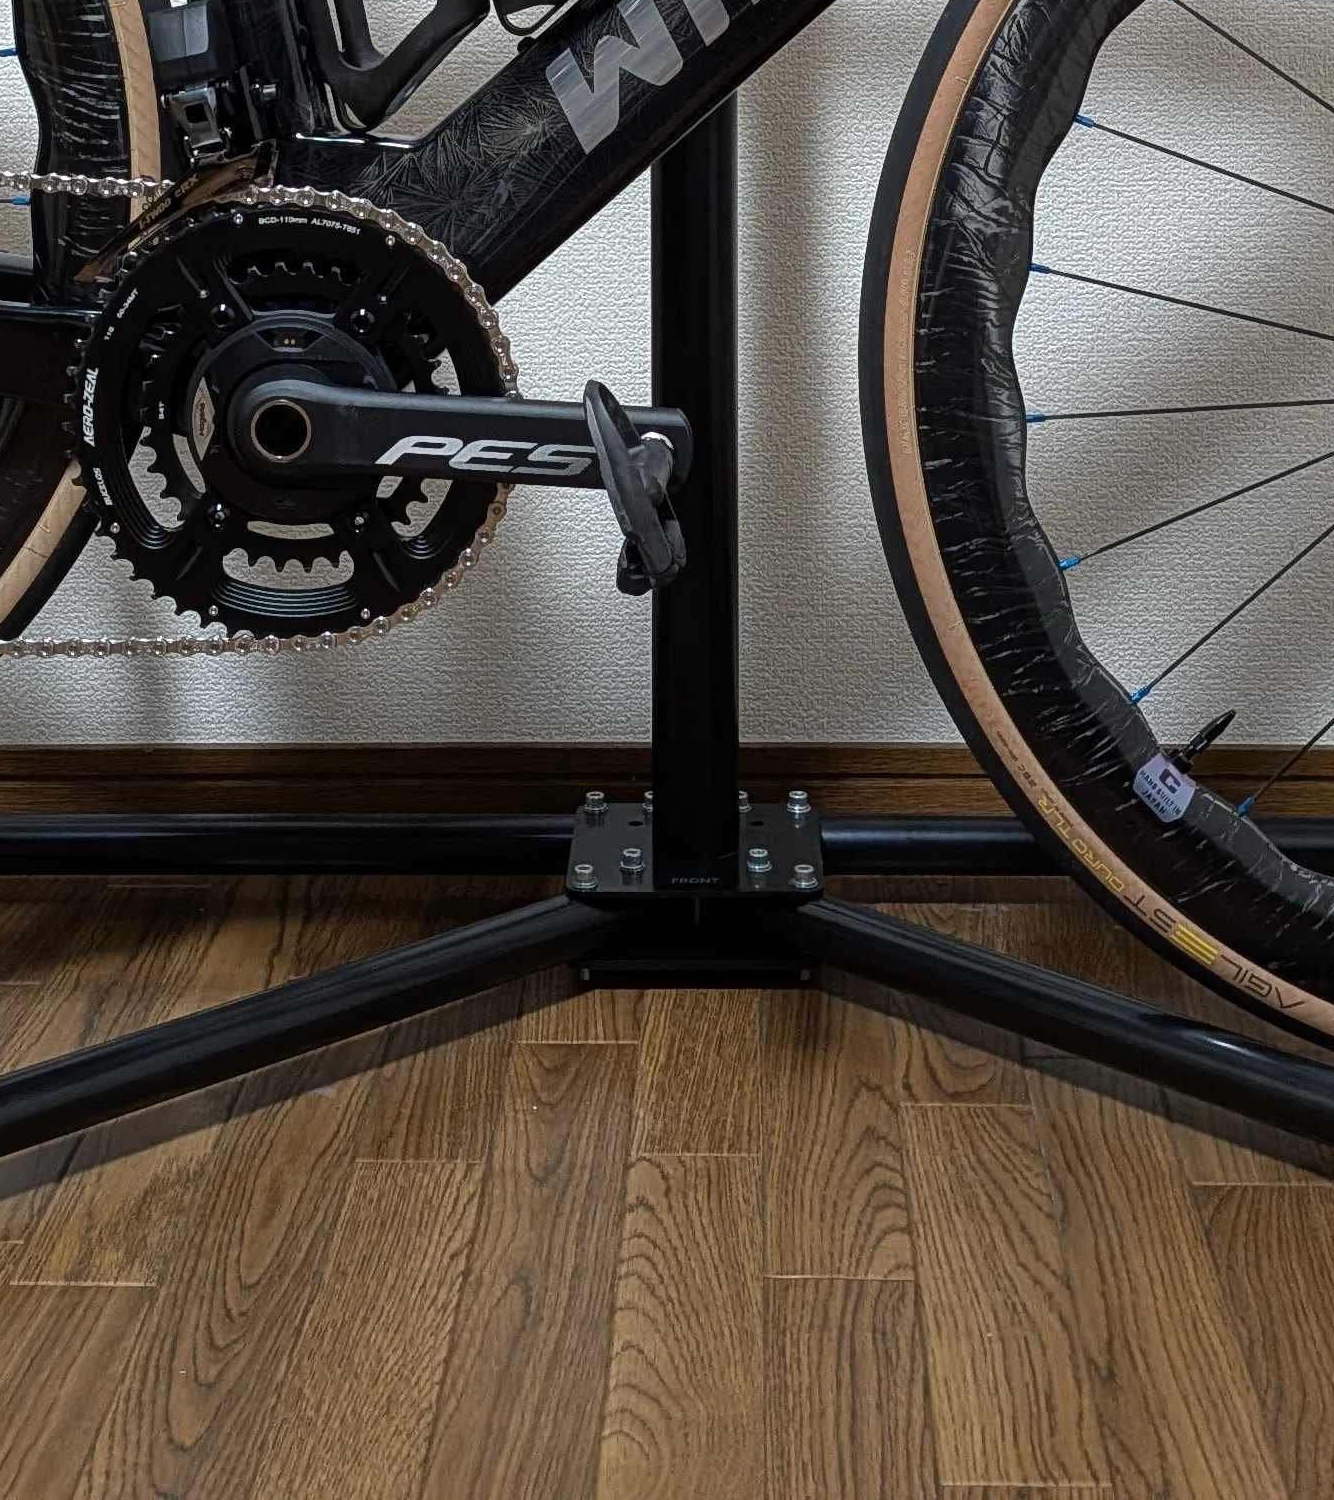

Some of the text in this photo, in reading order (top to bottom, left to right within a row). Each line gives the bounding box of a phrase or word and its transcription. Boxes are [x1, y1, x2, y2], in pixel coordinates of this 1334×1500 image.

[82, 367, 99, 447] AERO-ZEAL
[198, 402, 207, 437] Magene
[374, 435, 597, 476] PES
[93, 467, 114, 506] BUCKLOS
[1038, 795, 1072, 840] TLR
[1142, 789, 1167, 815] JAPAN
[1072, 838, 1125, 893] DURO
